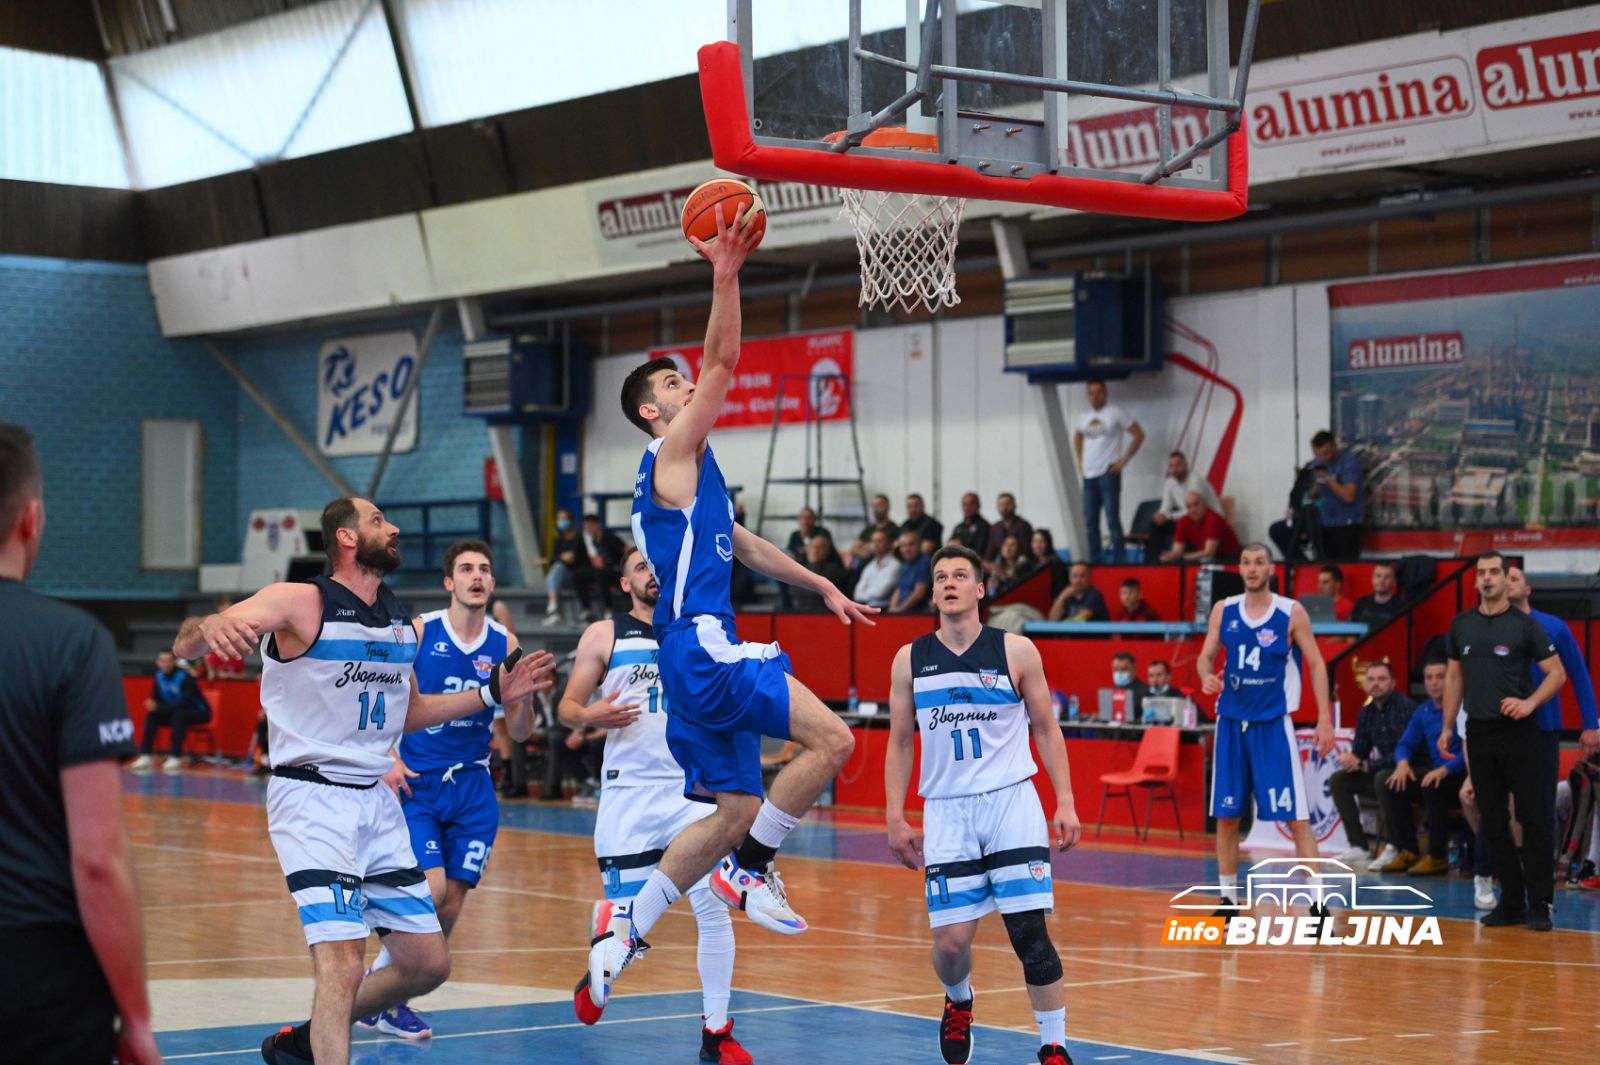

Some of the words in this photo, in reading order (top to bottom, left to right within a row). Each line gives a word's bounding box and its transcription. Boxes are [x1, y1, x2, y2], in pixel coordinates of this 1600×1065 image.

[1253, 73, 1469, 142] alumina
[1351, 335, 1463, 369] alumina
[325, 354, 414, 448] KESO
[1237, 643, 1262, 672] 14
[358, 690, 386, 731] 14
[929, 705, 998, 731] Зворник
[950, 727, 983, 761] 11
[1268, 786, 1293, 814] 14
[926, 874, 951, 907] 11
